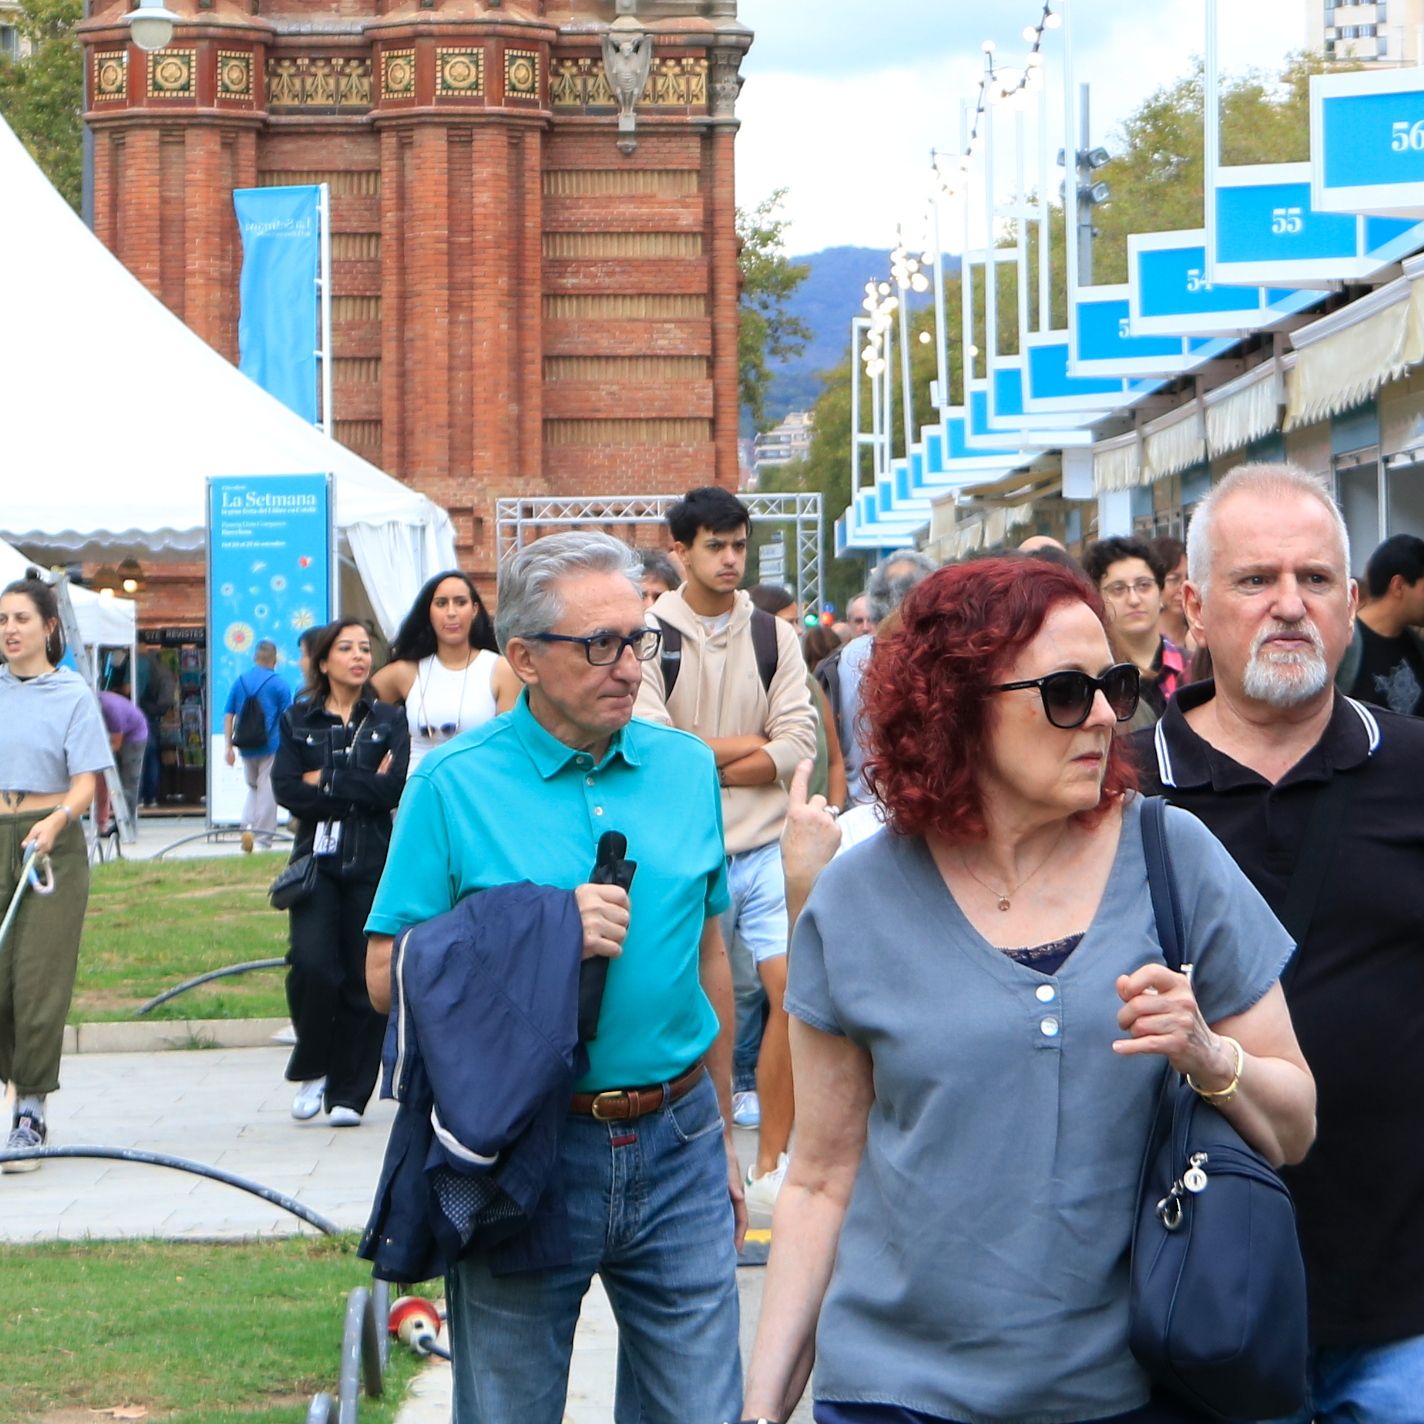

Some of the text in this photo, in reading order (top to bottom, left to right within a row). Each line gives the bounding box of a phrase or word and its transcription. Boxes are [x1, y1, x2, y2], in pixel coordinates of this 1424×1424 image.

[1271, 207, 1302, 233] 55
[223, 491, 317, 507] La Setmana
